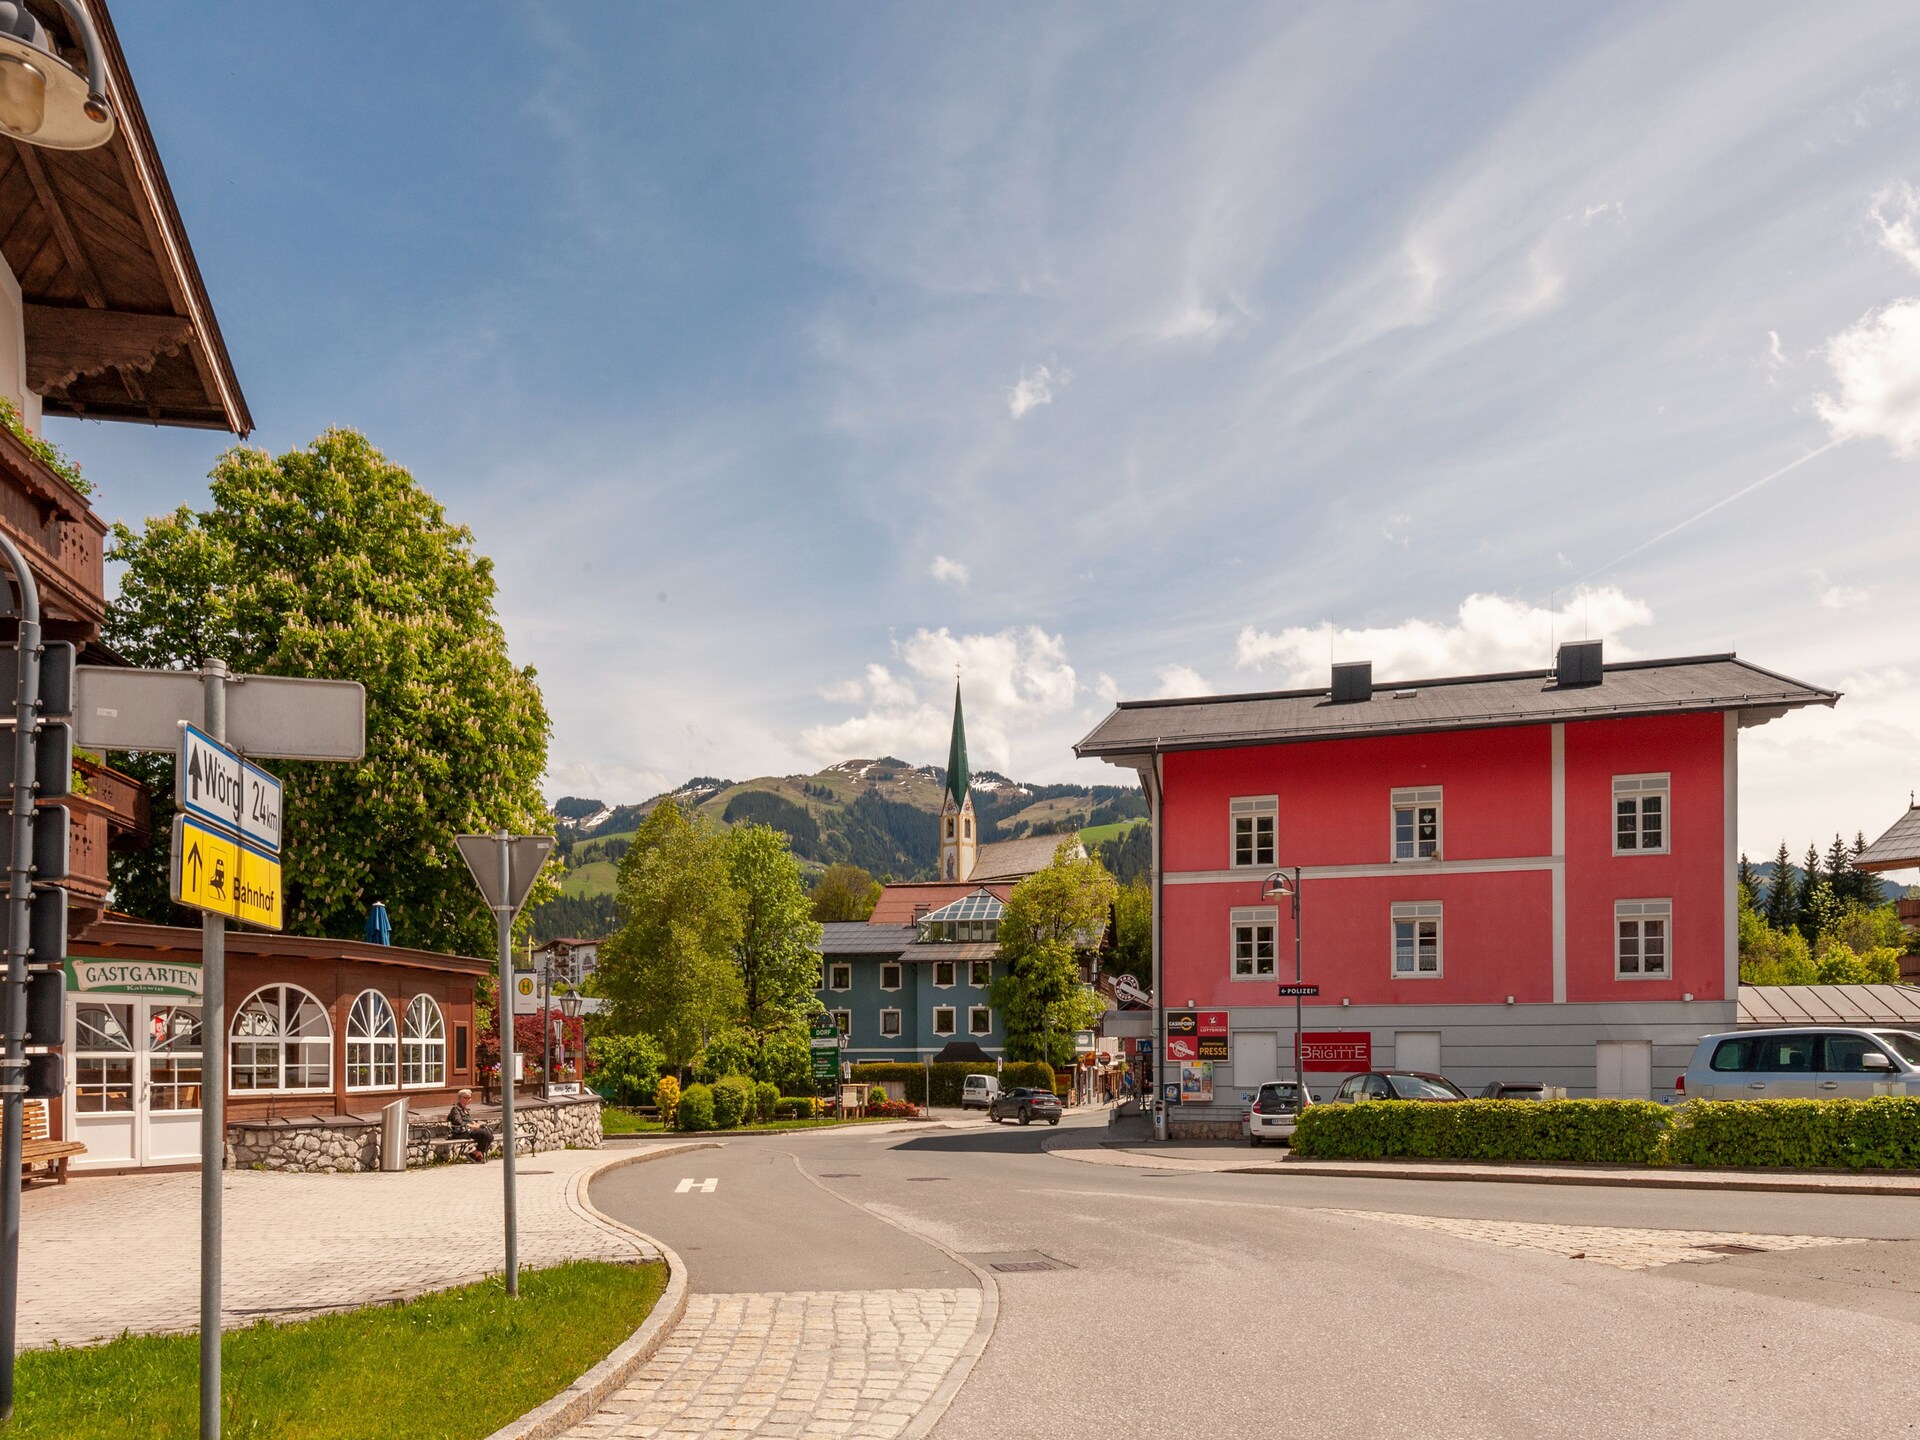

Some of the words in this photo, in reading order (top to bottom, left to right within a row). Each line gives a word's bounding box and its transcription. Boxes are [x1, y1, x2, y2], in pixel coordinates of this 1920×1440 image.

[203, 750, 244, 822] Wörgl
[252, 781, 267, 825] 24
[266, 804, 278, 831] km
[233, 877, 275, 912] Bahnhof
[86, 966, 198, 986] GASTGARTEN
[522, 981, 530, 992] H
[1199, 1047, 1227, 1055] PRESSE
[1301, 1046, 1367, 1059] BRIGITTE
